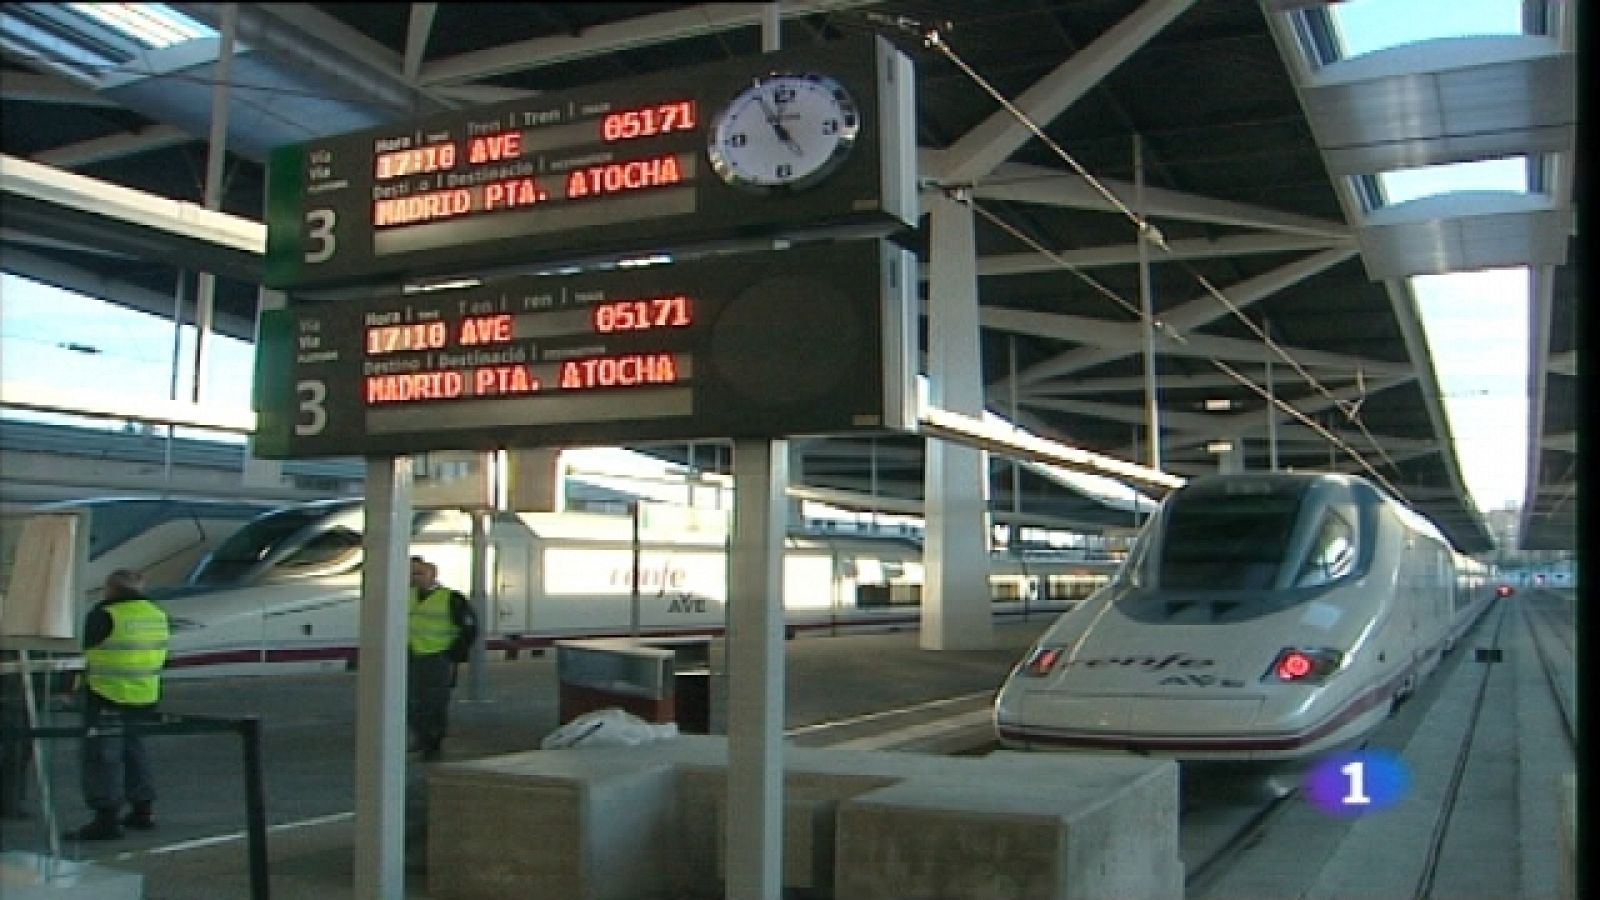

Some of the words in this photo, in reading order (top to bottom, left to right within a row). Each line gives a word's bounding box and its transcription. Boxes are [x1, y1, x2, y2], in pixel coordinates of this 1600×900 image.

[376, 143, 456, 179] 17:10
[469, 132, 522, 163] AVE
[603, 101, 696, 140] 05171
[374, 189, 471, 227] MADRID
[484, 179, 550, 211] PTA.
[568, 156, 681, 198] ATOCHA
[303, 208, 336, 264] 3
[367, 321, 446, 354] 17:10
[459, 315, 511, 345] AVE
[596, 297, 691, 331] 05171
[294, 379, 327, 436] 3
[365, 372, 462, 404] MADRID
[475, 364, 541, 395] PTA.
[561, 355, 676, 389] ATOCHA
[667, 592, 707, 613] AVE
[1158, 673, 1246, 688] AVE
